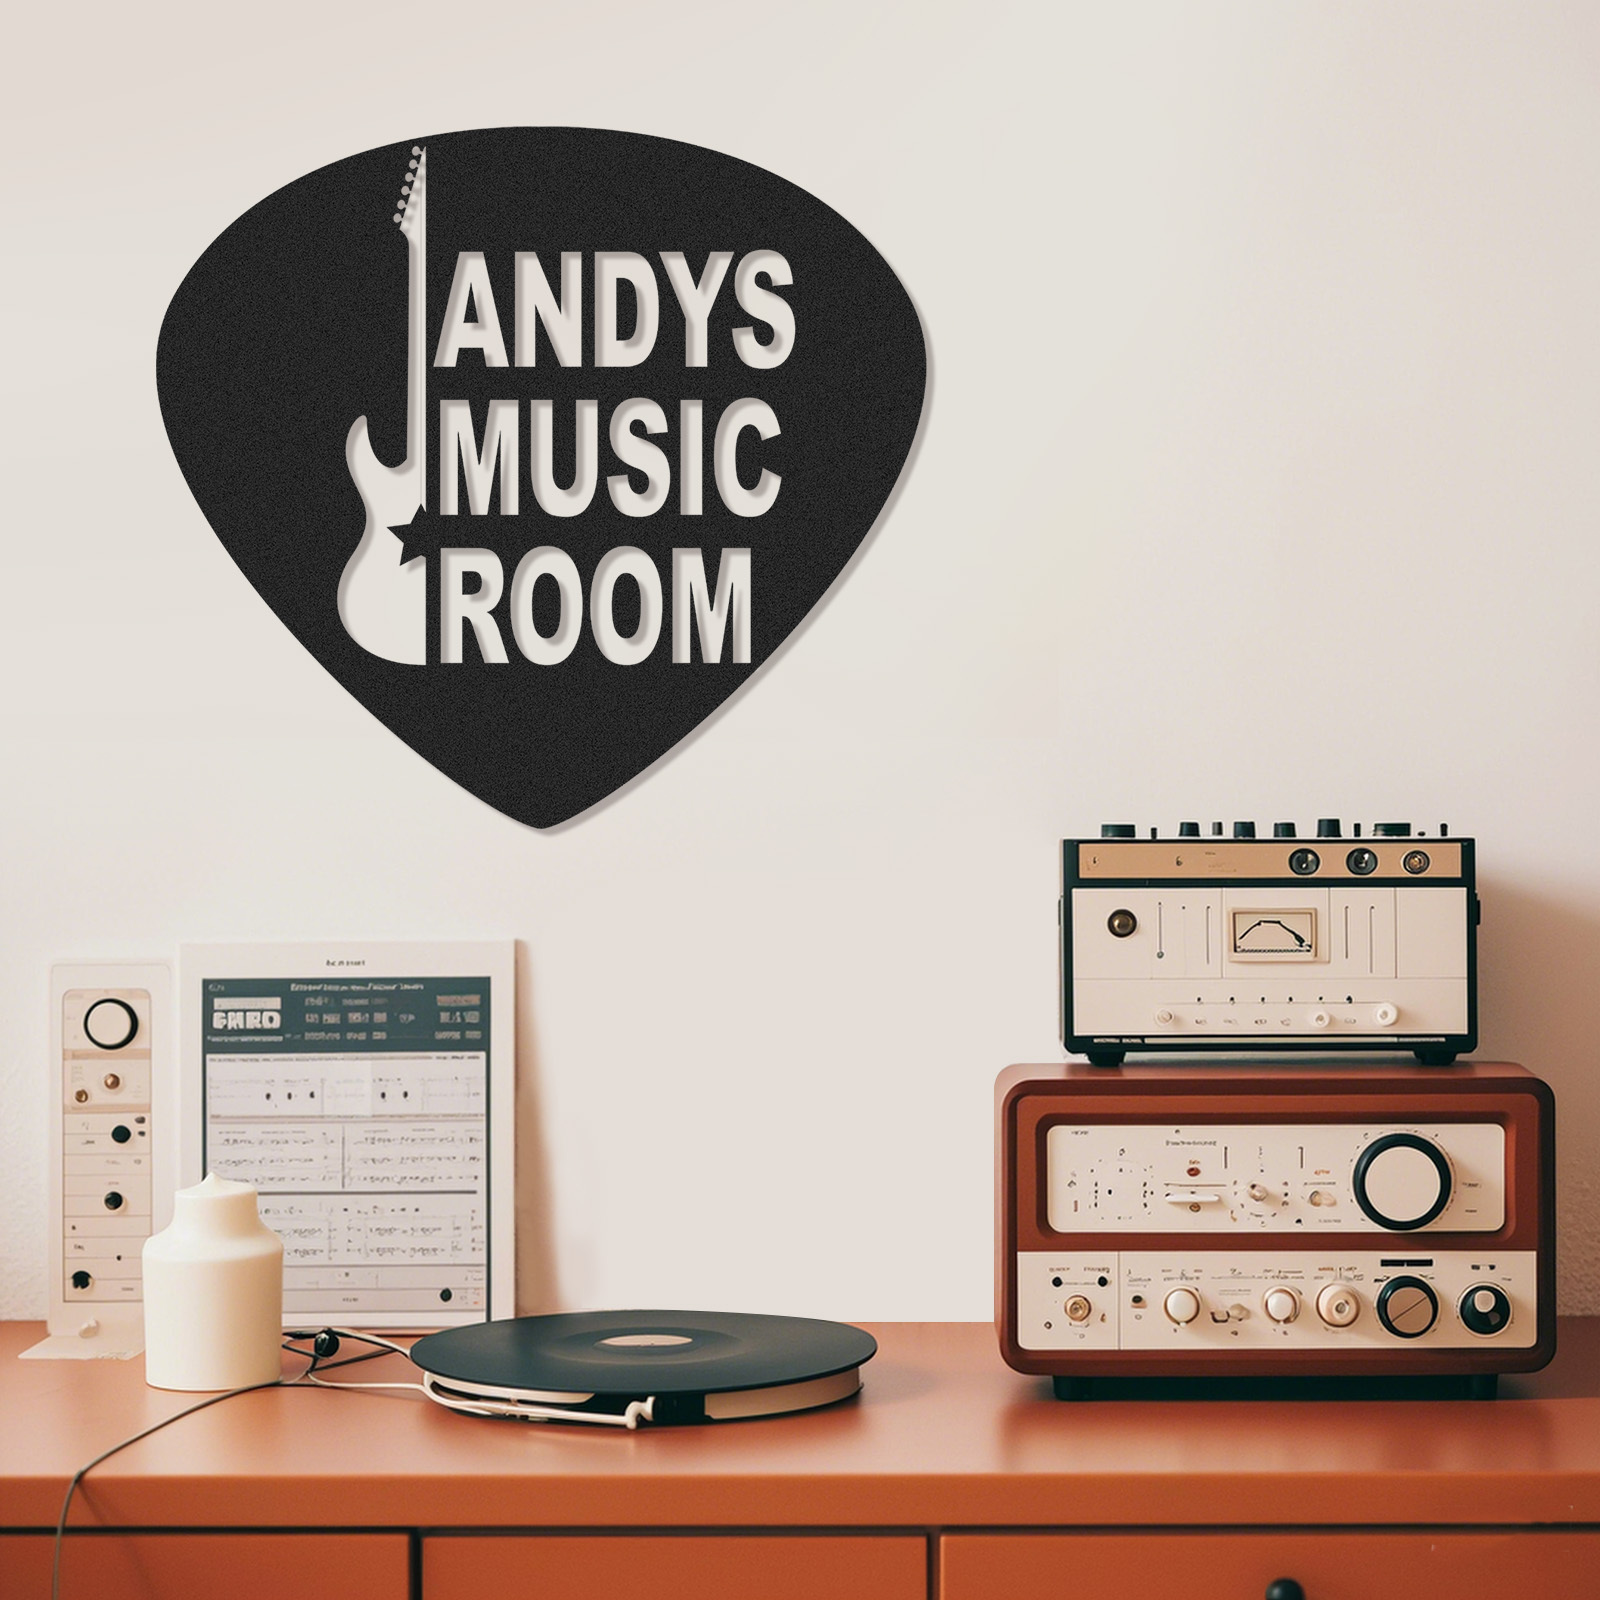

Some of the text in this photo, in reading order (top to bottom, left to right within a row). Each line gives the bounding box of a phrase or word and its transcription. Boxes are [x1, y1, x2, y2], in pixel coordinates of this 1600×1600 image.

[433, 250, 796, 370] ANDYS
[440, 398, 782, 518] MUSIC
[441, 546, 752, 666] ROOM
